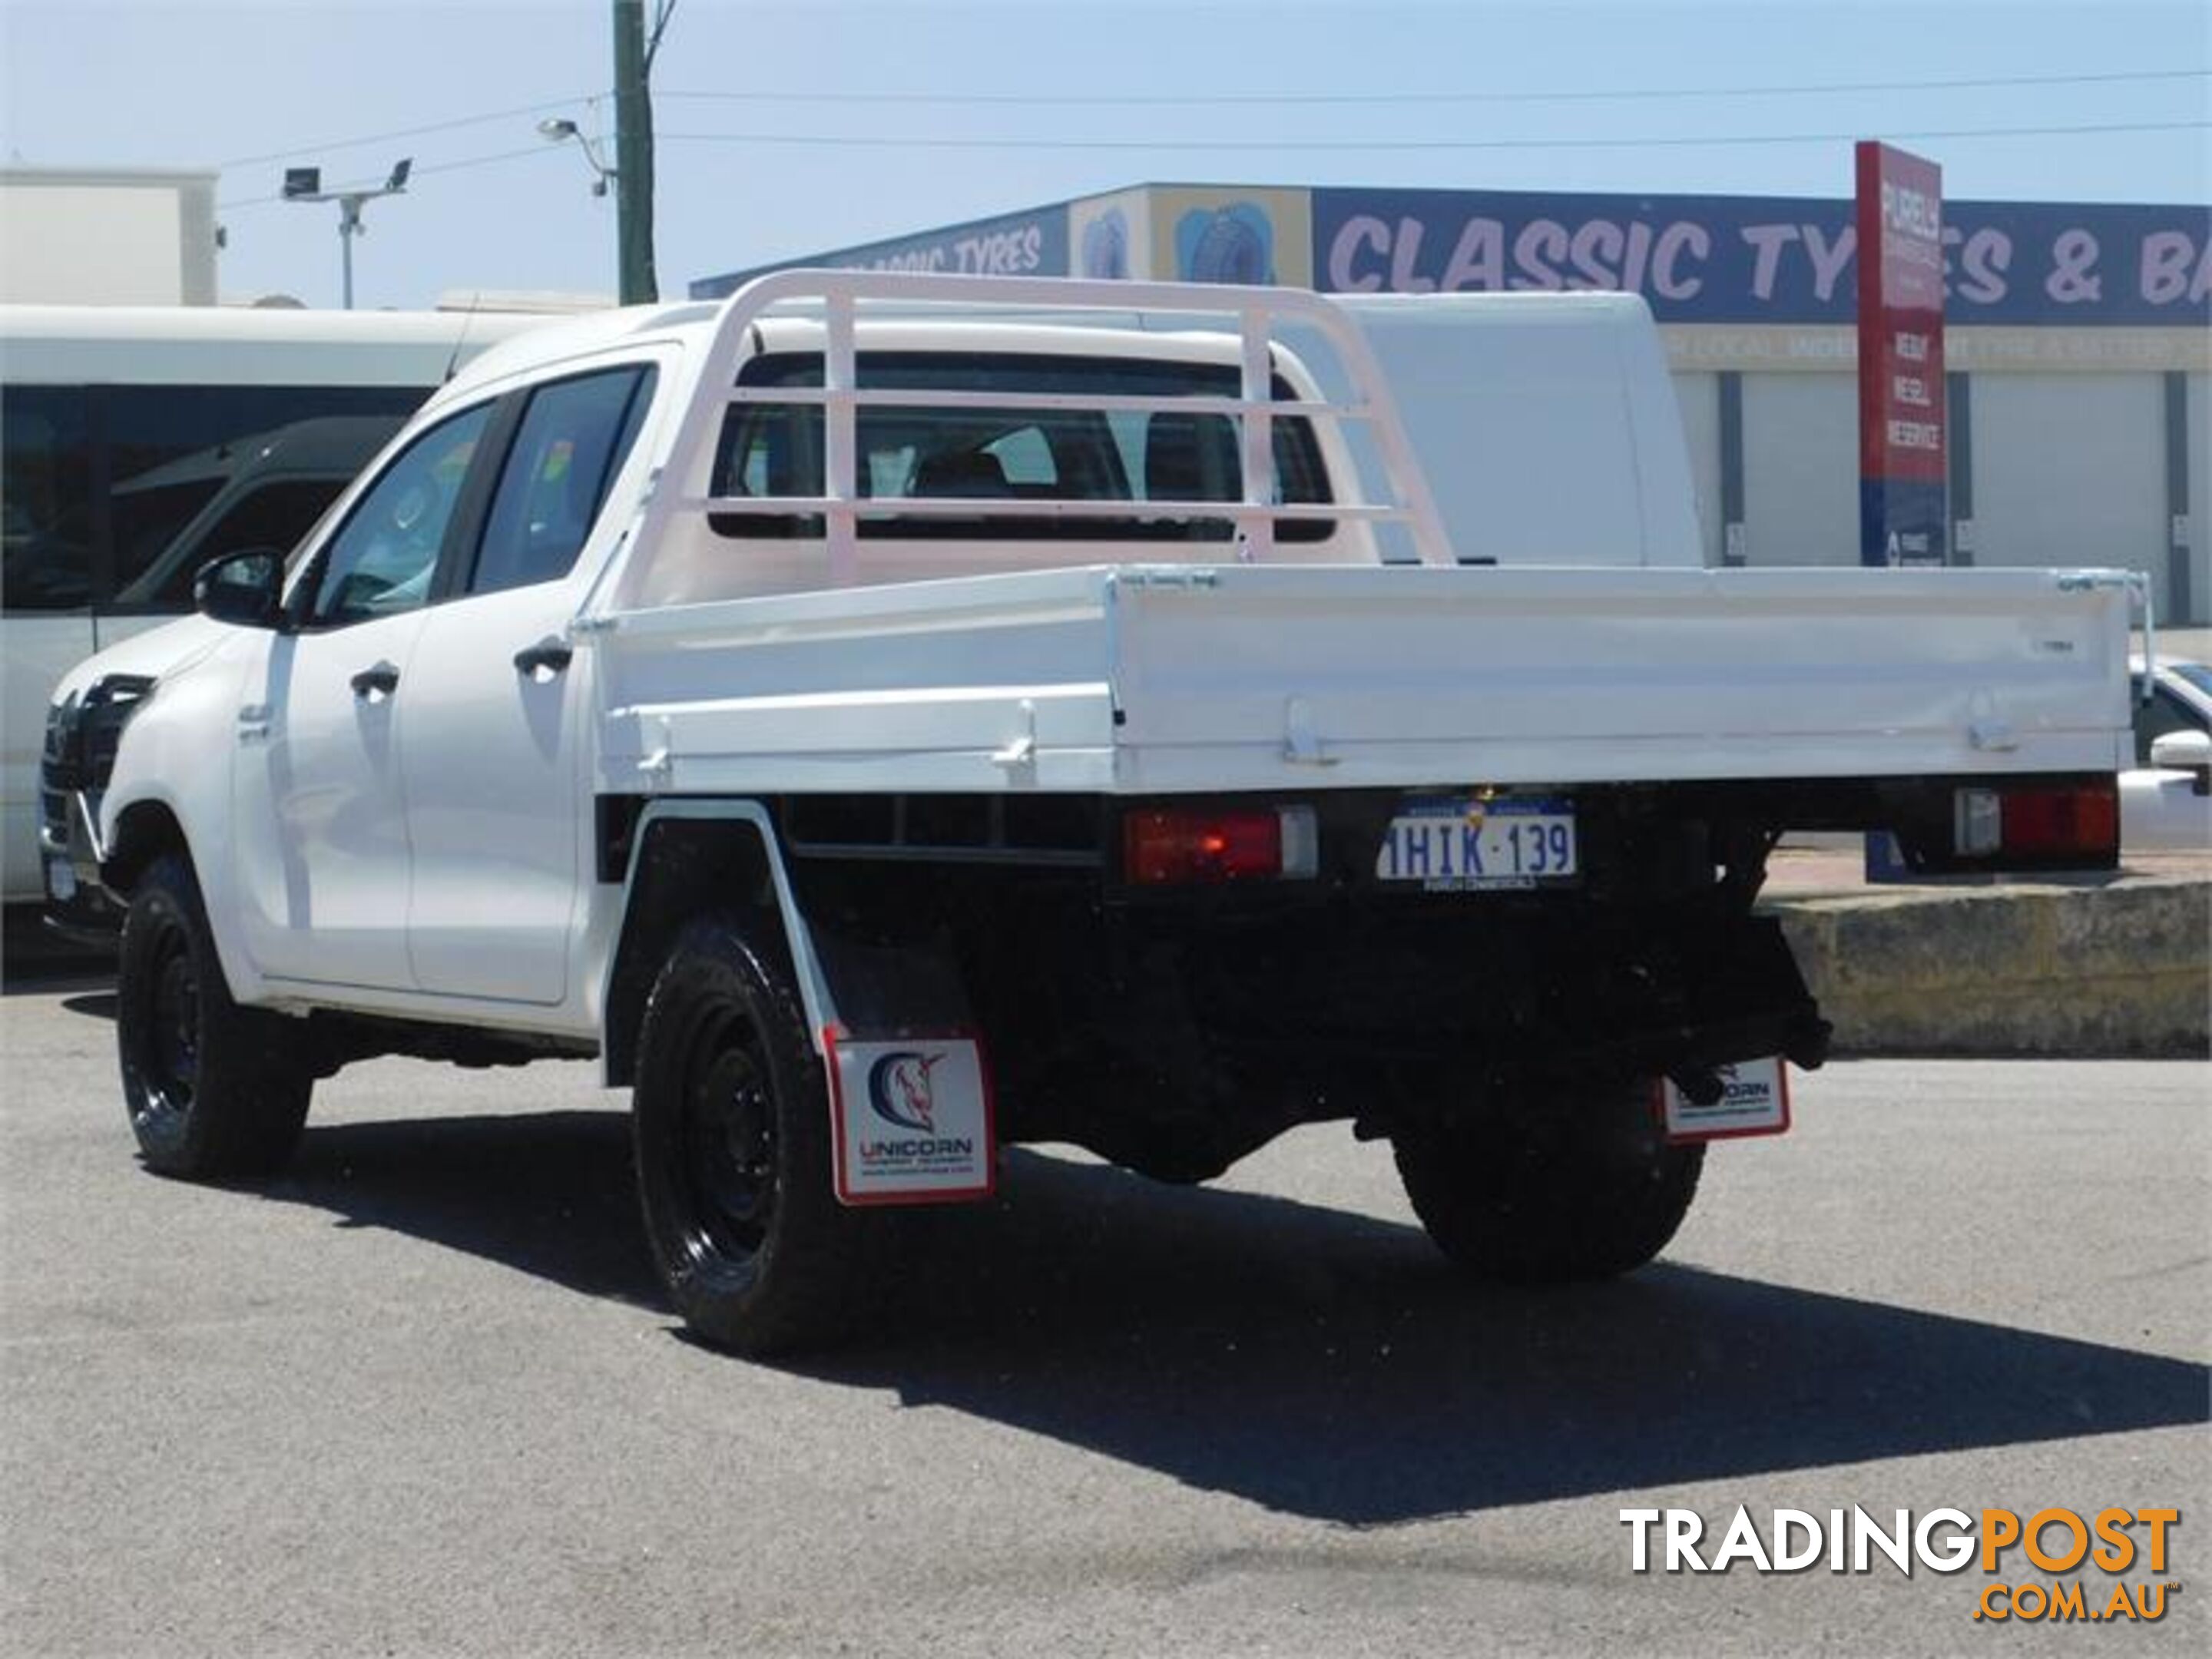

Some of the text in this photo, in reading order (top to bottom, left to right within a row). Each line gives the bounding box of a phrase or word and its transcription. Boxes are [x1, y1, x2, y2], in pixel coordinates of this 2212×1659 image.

[955, 223, 1041, 276] TYRES
[1329, 215, 1710, 300] CLASSIC
[1740, 224, 2012, 304] TYS
[2045, 227, 2102, 303] &
[859, 1137, 973, 1157] UNICORN
